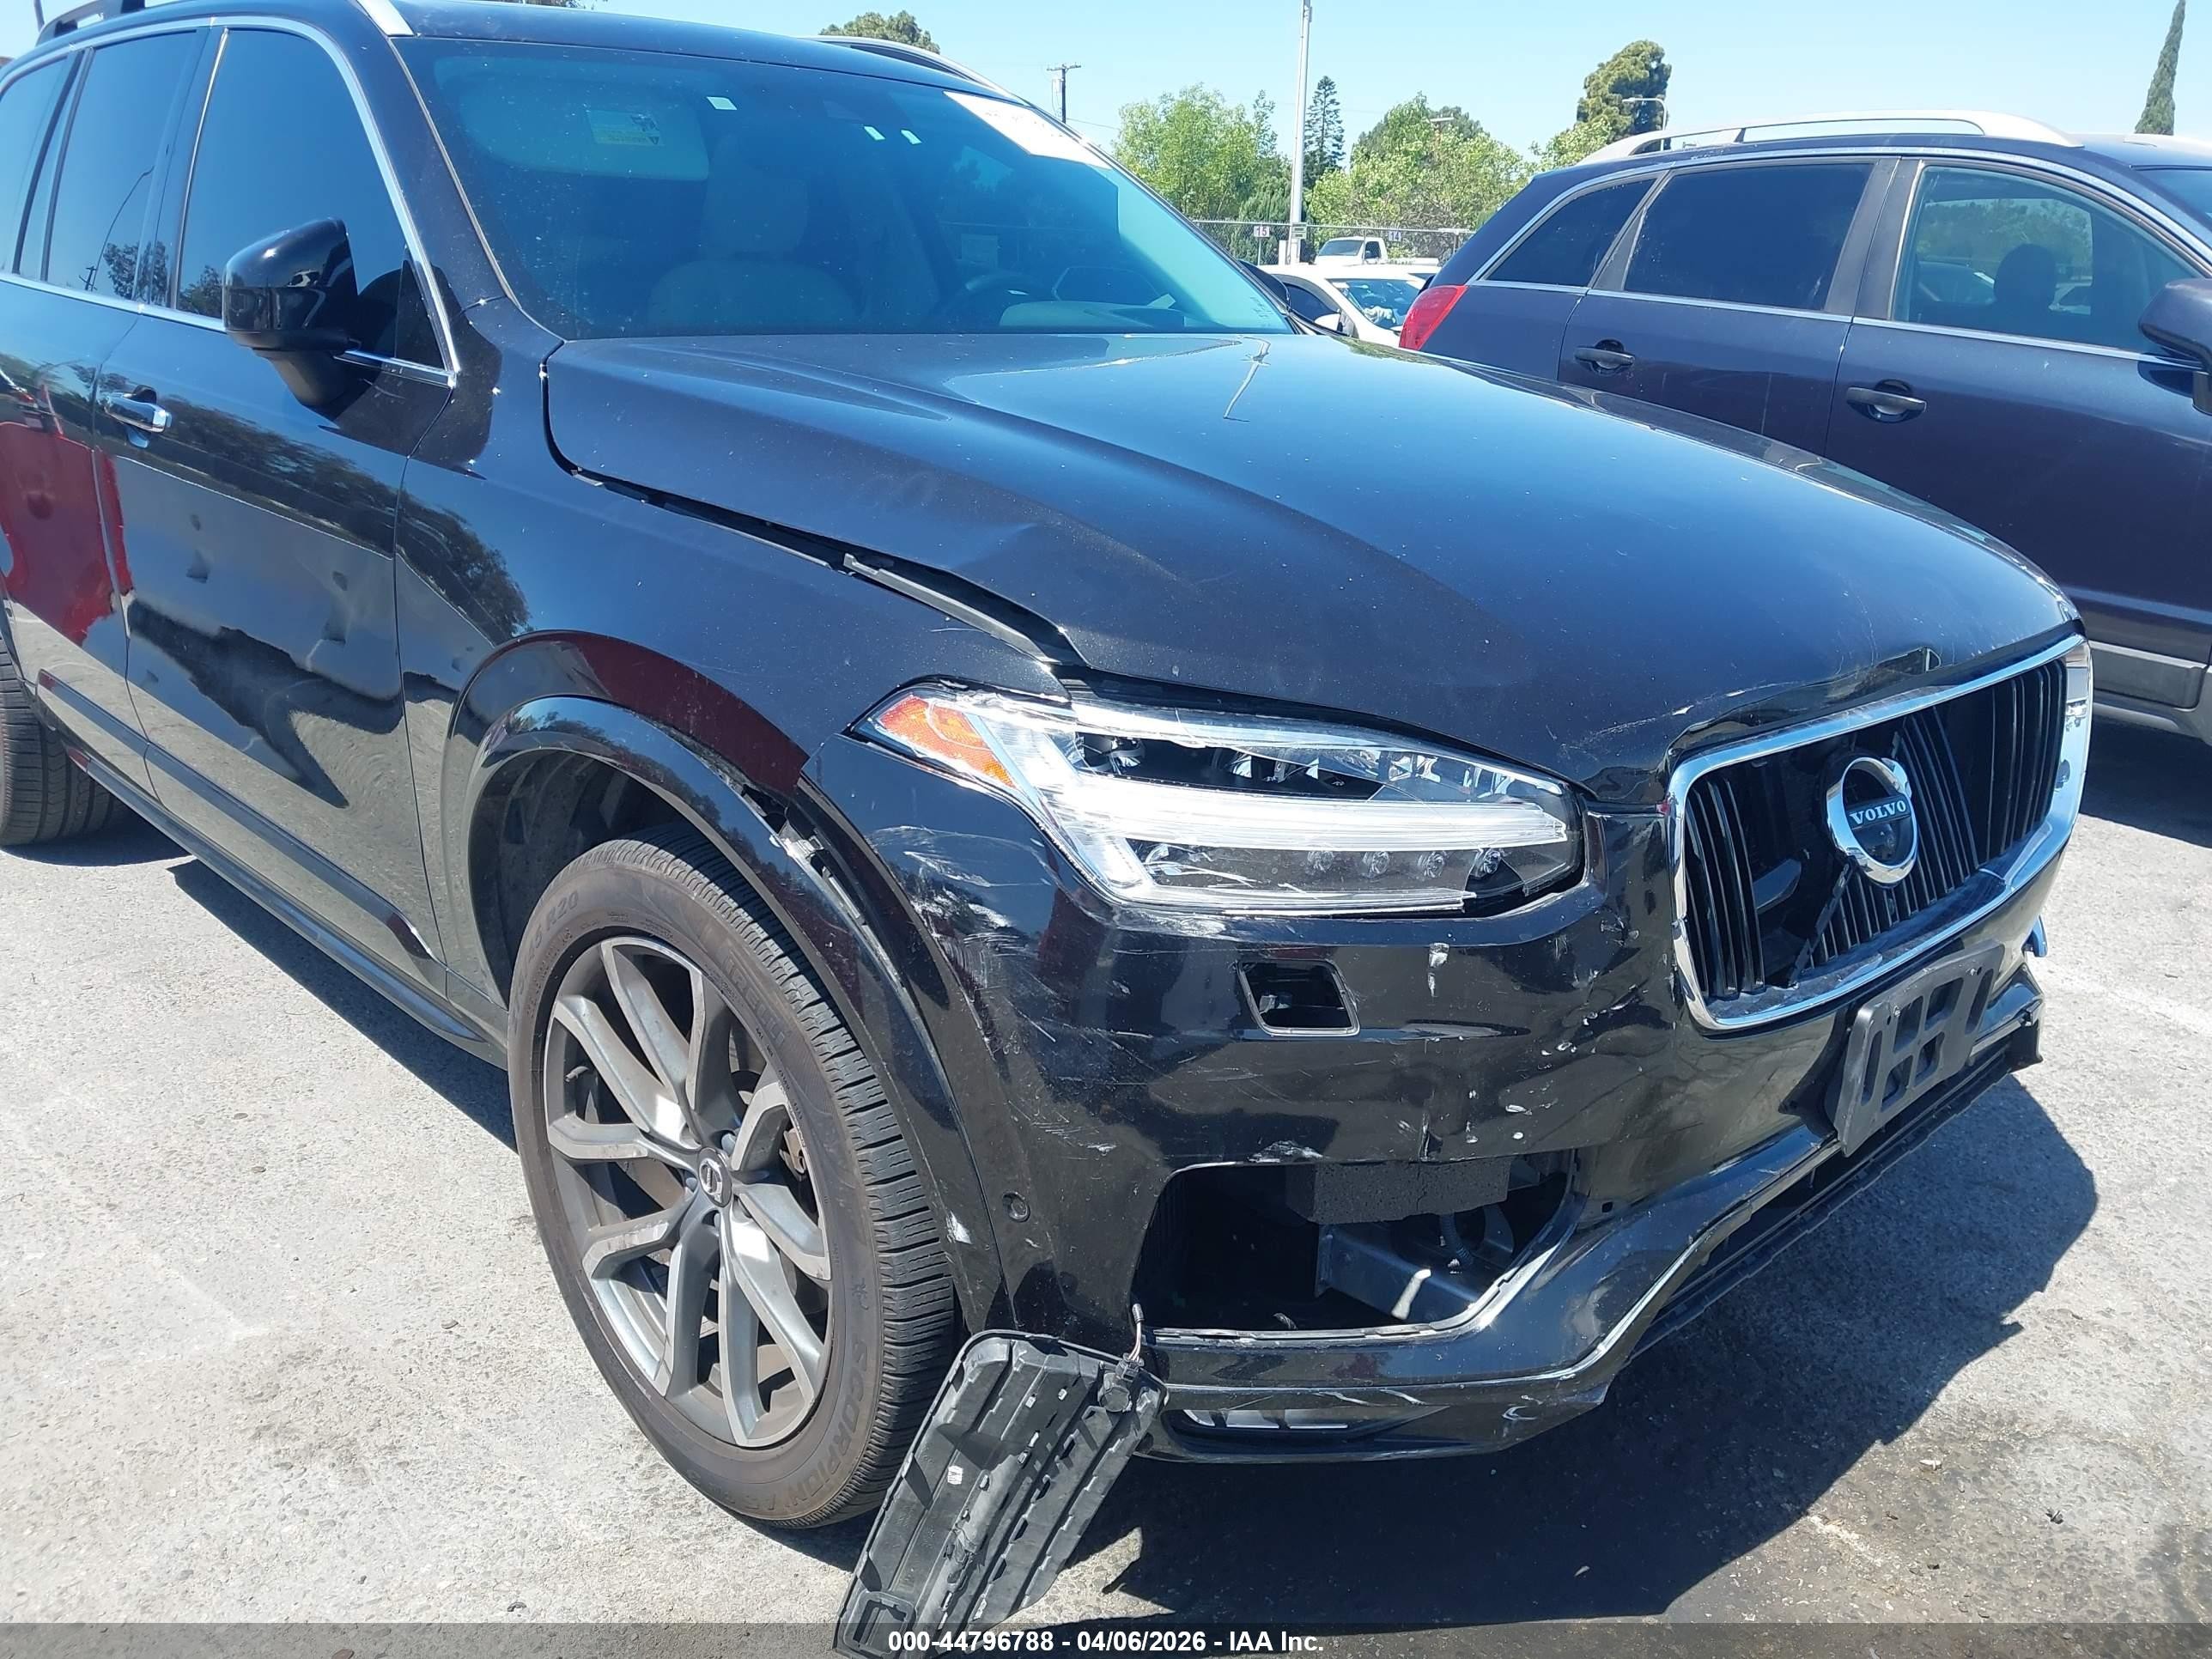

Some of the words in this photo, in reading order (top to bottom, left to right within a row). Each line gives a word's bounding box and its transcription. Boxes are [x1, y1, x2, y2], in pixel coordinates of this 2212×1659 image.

[1256, 226, 1267, 236] 15
[1849, 799, 1907, 825] VOLVO
[783, 1336, 869, 1508] SCORPION
